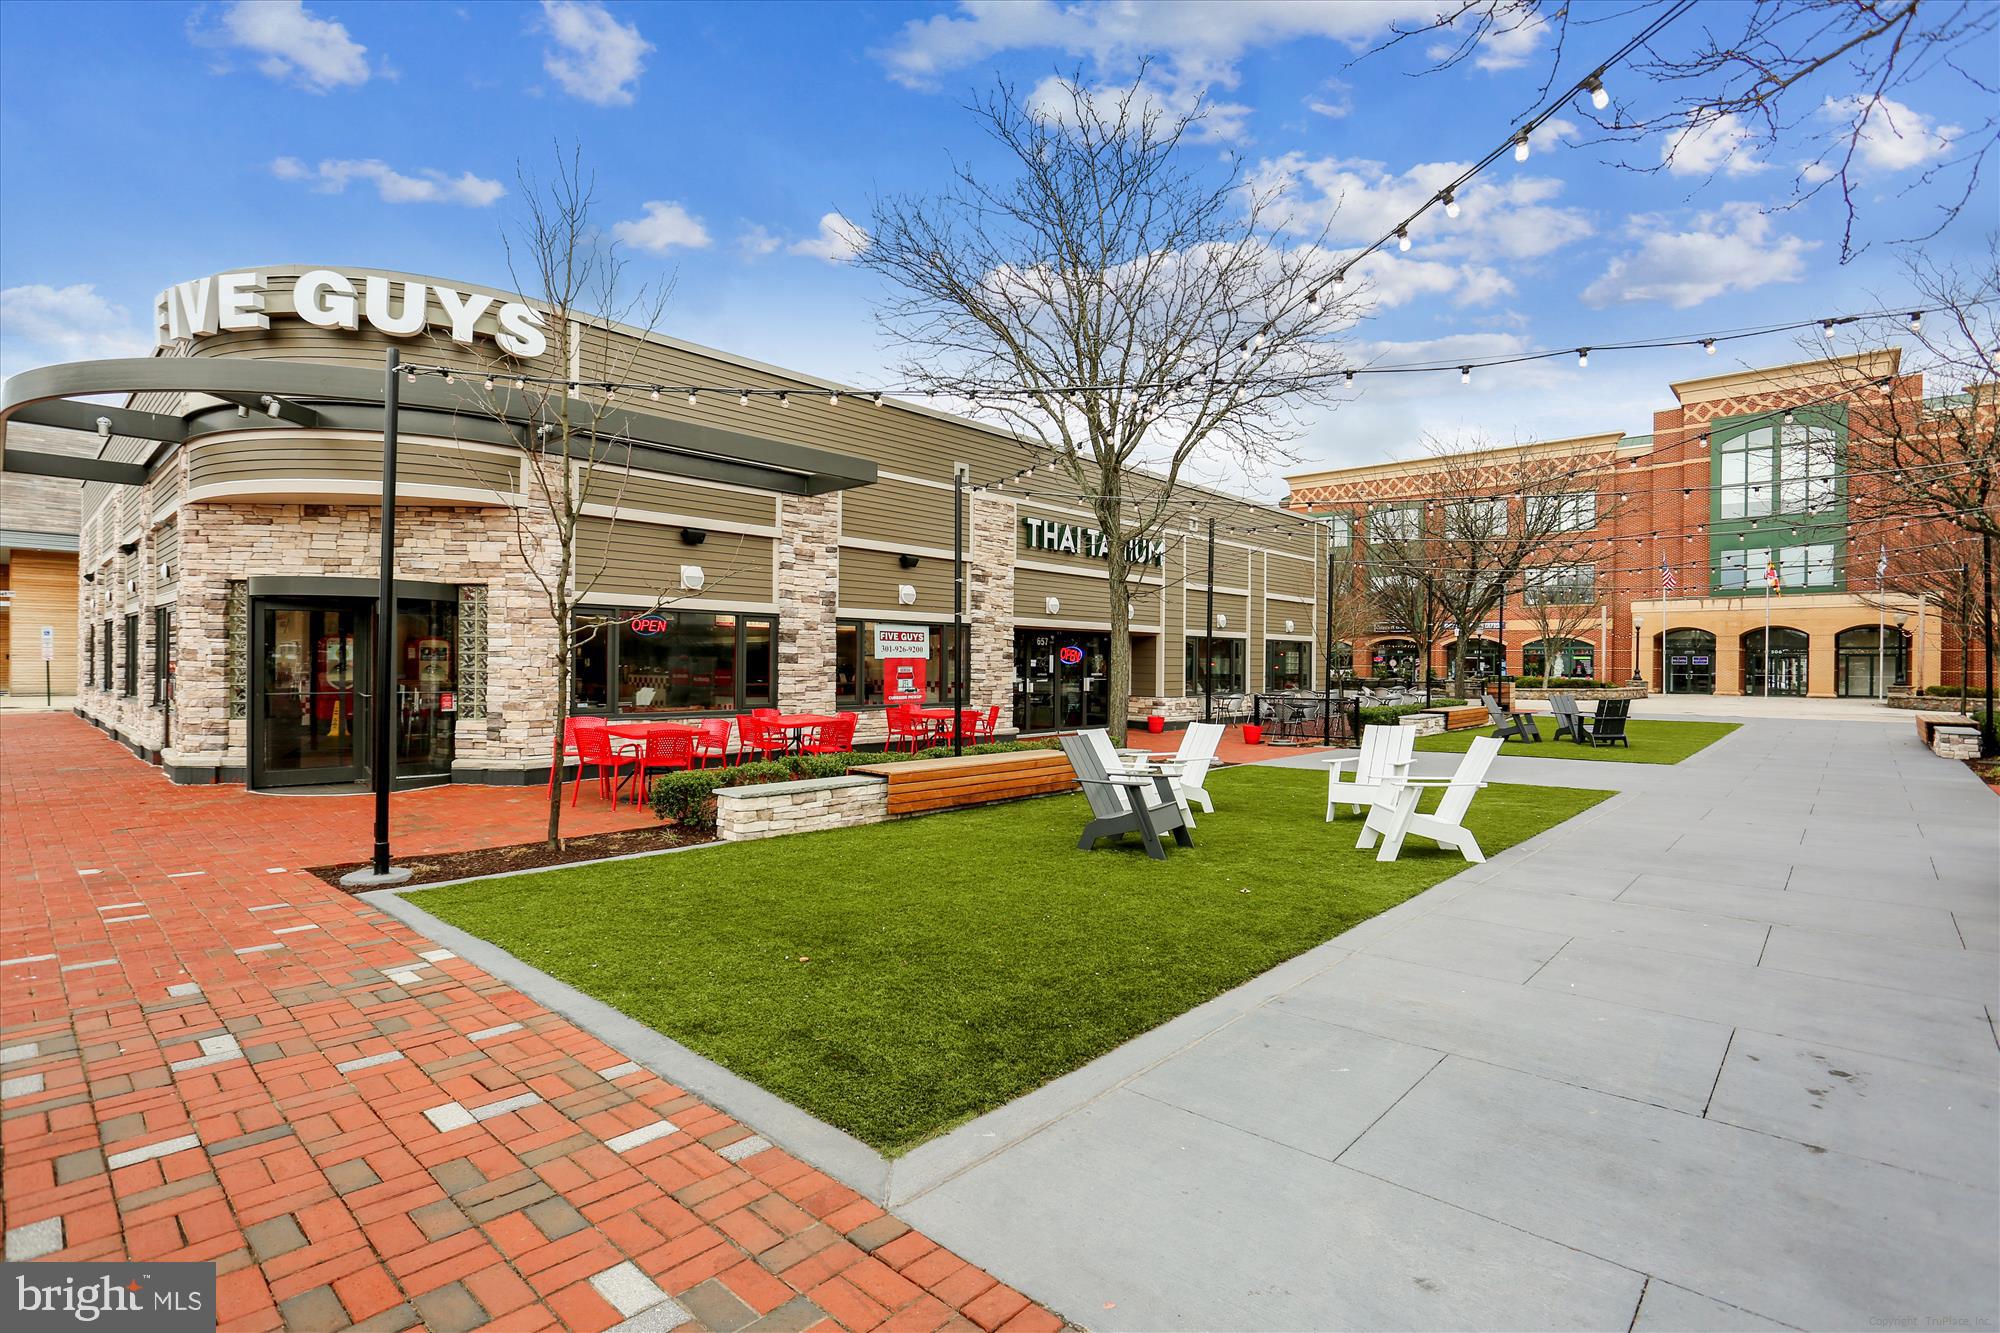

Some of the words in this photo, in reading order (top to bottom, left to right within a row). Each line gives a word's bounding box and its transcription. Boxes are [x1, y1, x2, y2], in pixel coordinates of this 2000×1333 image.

[154, 271, 270, 350] FIVE
[293, 269, 547, 359] GUYS
[1022, 517, 1081, 554] THAI
[1085, 528, 1165, 567] TAIUM
[631, 618, 668, 633] OPEN
[880, 631, 899, 641] FIVE
[900, 633, 924, 641] GUYS
[1036, 637, 1049, 646] 657
[880, 645, 924, 653] 301-926-9200
[1060, 647, 1081, 662] OPEN
